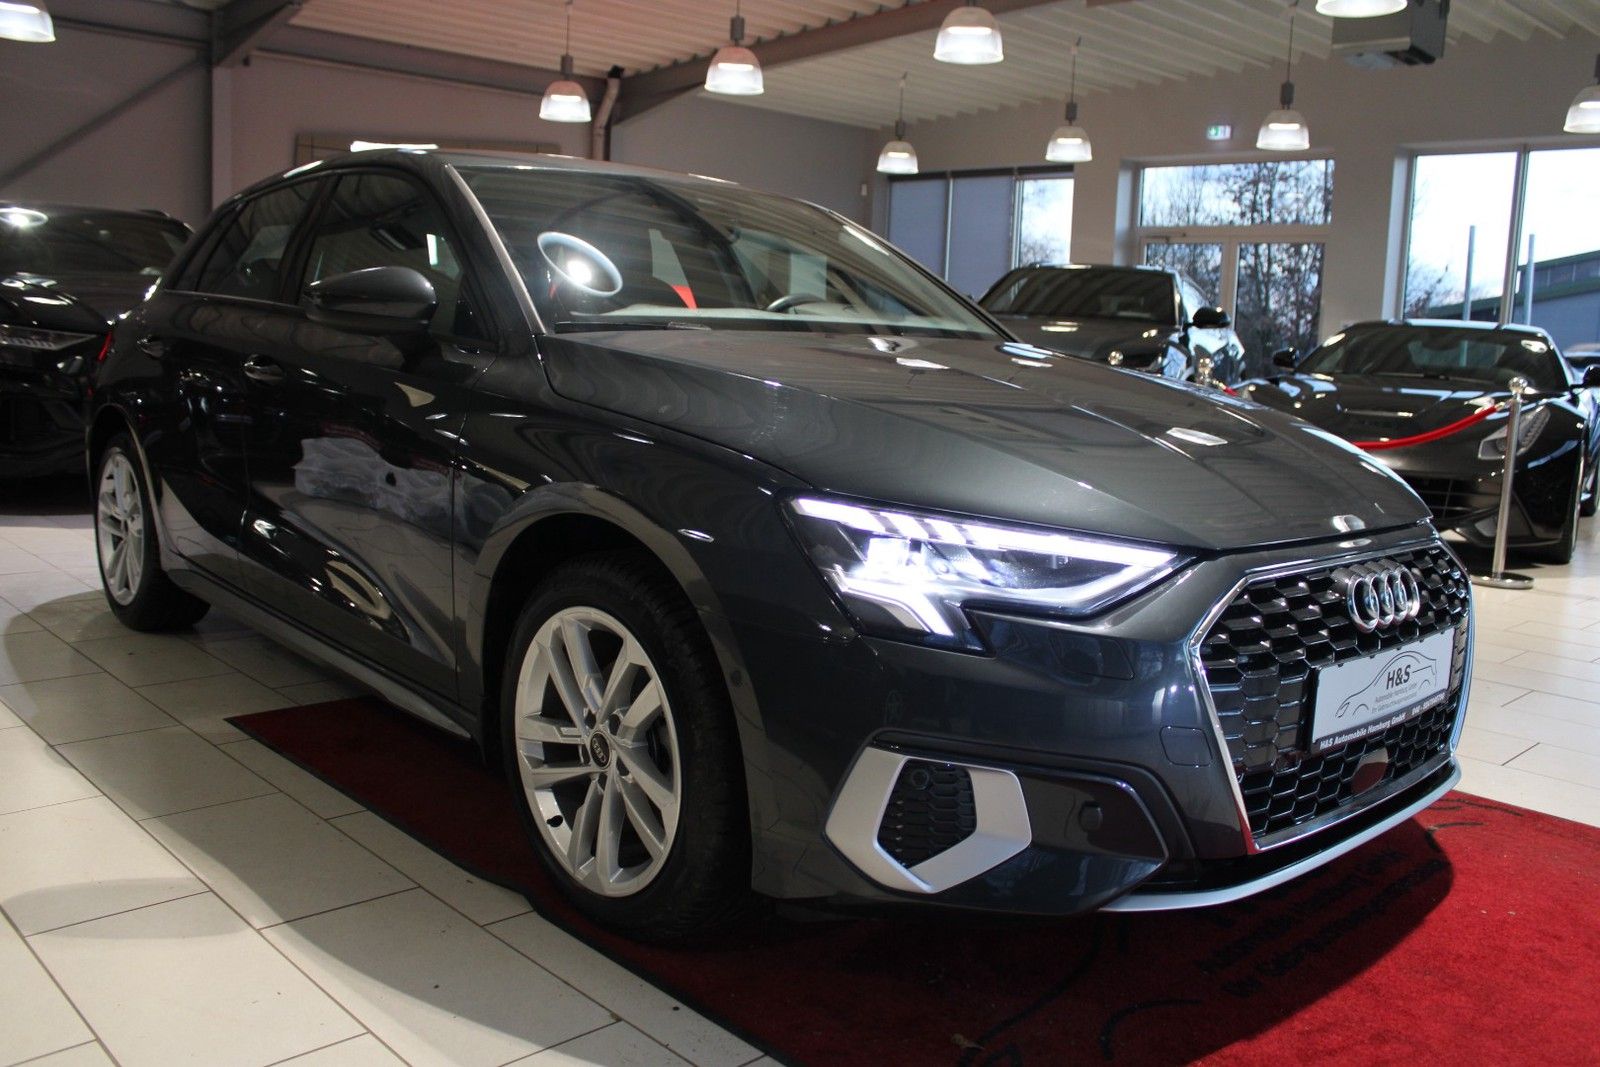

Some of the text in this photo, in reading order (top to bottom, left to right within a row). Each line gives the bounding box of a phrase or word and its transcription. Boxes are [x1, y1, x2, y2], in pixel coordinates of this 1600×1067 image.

[1386, 664, 1411, 690] H&S
[1334, 728, 1367, 745] Automobile
[1367, 719, 1391, 734] Hamburg
[1391, 712, 1406, 725] GmbH
